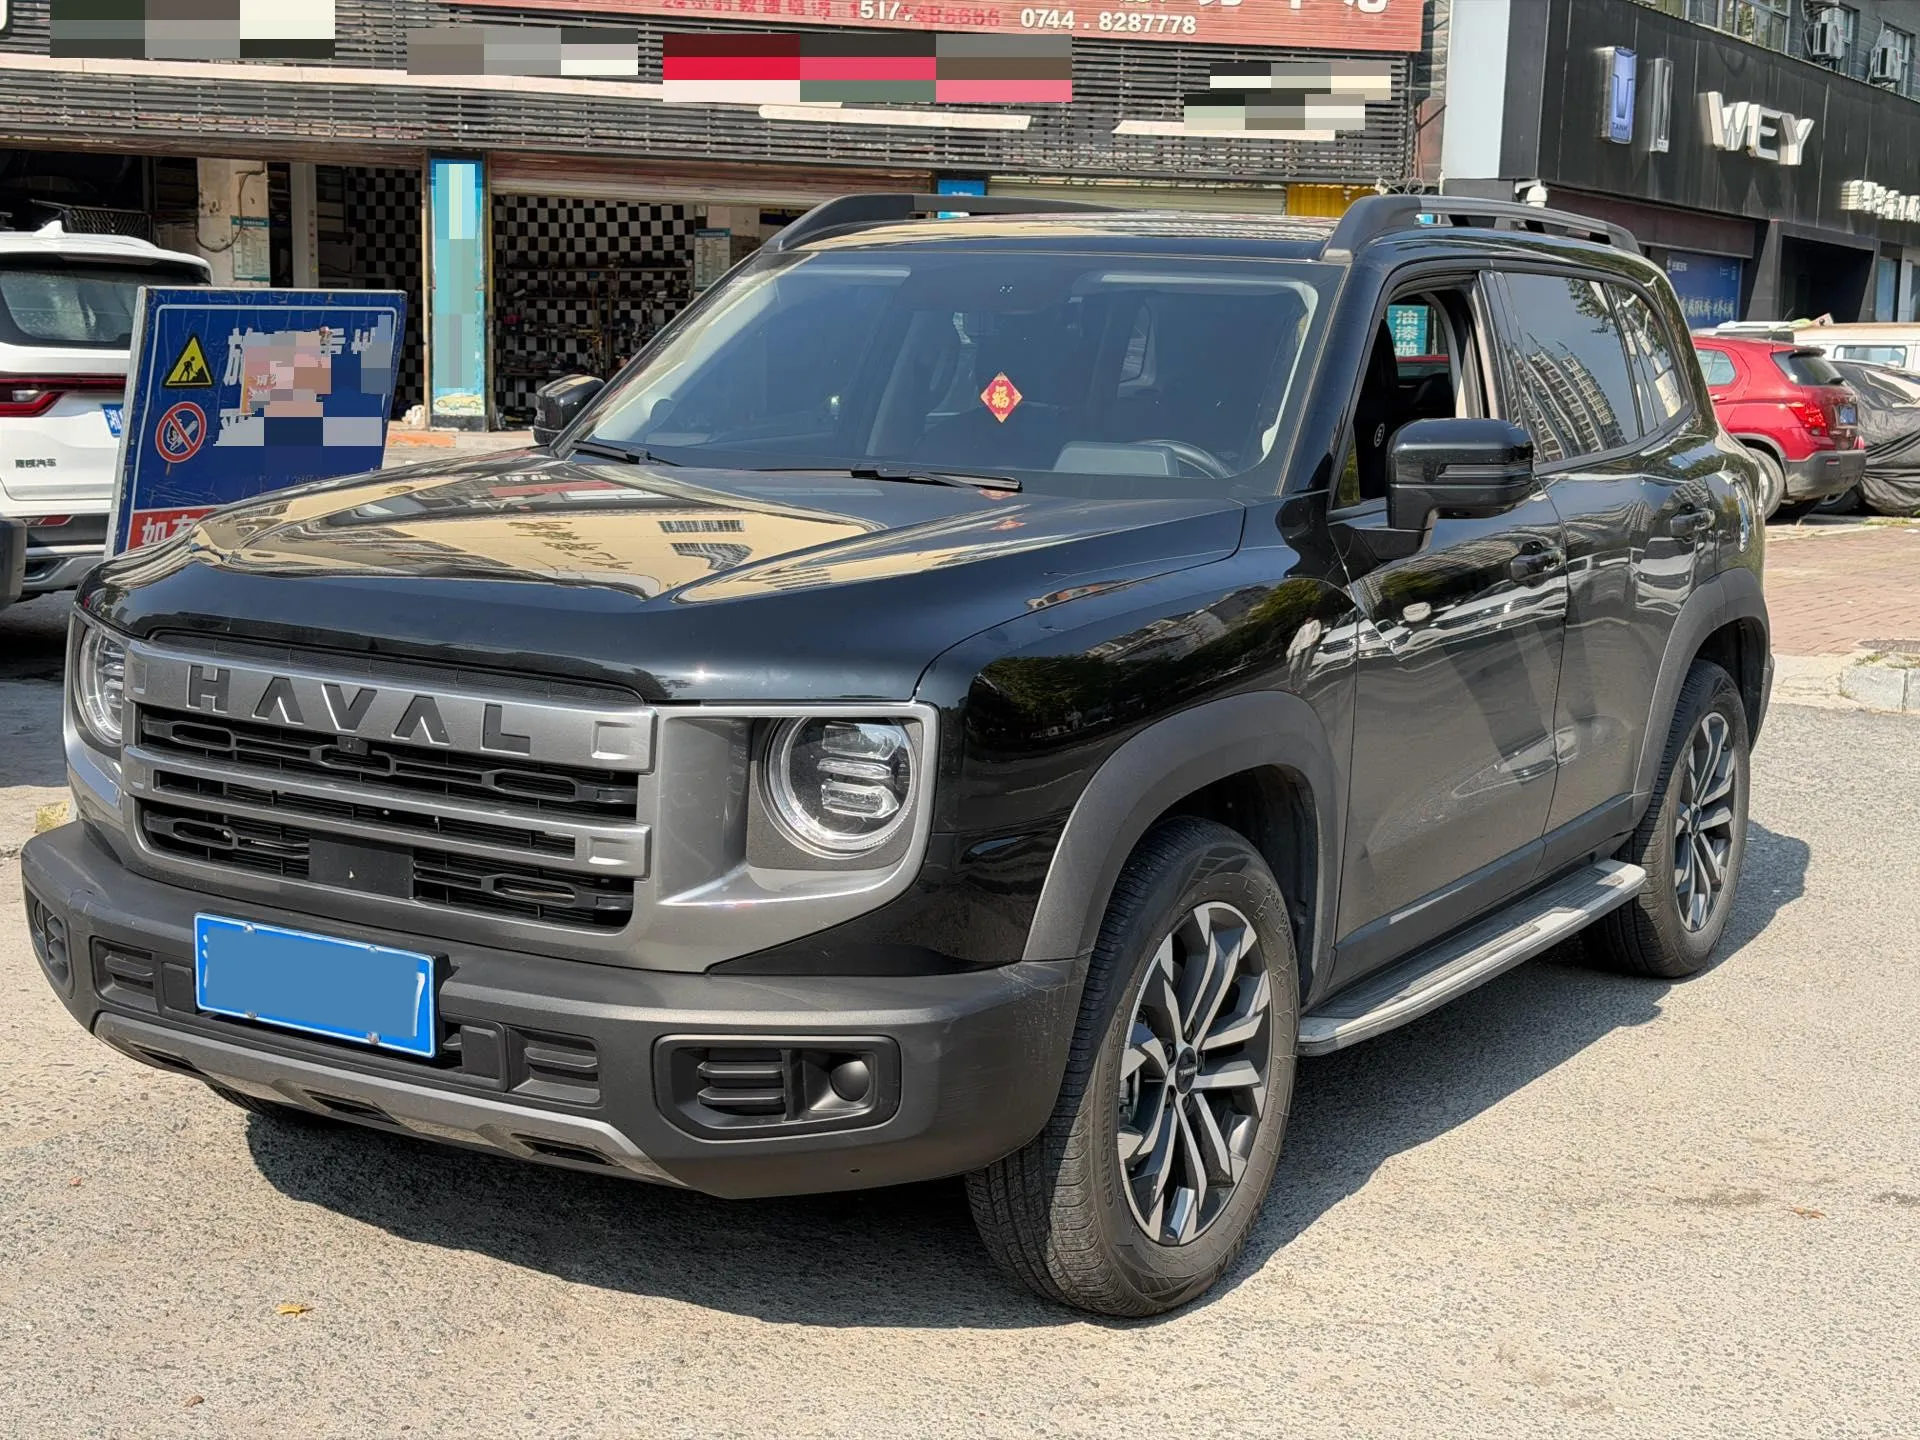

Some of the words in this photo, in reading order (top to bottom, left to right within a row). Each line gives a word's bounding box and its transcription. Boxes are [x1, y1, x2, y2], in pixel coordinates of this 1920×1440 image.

[1020, 8, 1075, 30] 0744
[1098, 12, 1197, 34] 8287778
[1700, 90, 1814, 165] WEY
[991, 385, 1010, 409] 福
[185, 664, 532, 756] HAVAL
